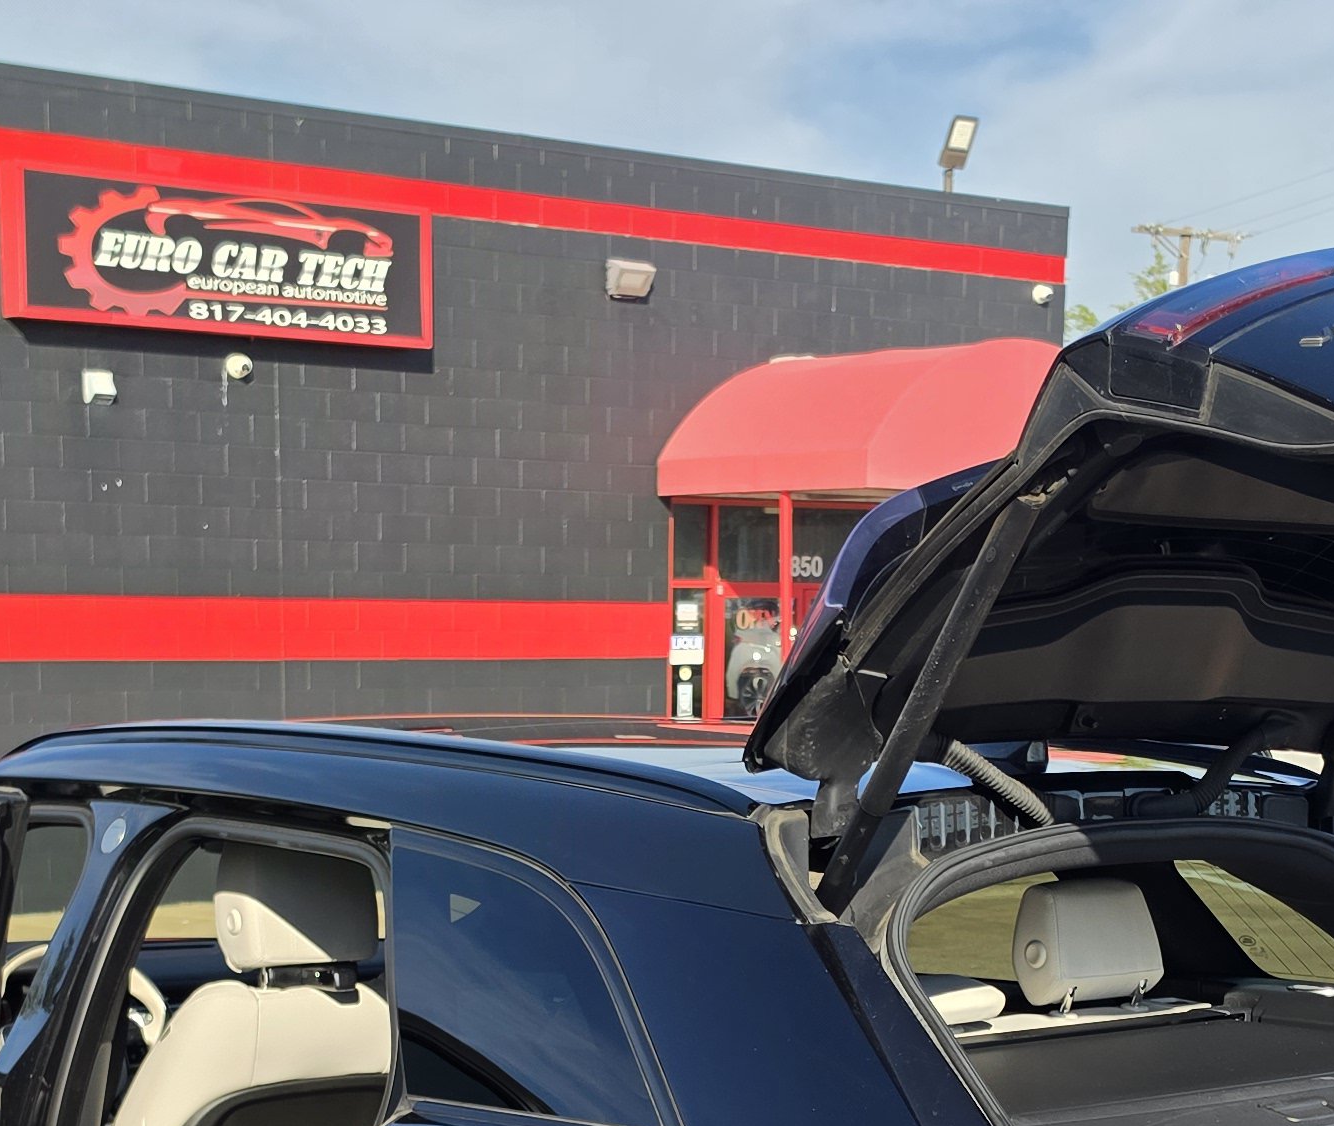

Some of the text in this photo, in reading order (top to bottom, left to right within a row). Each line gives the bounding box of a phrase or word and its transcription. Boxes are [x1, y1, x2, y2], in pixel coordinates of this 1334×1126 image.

[94, 230, 392, 292] EURO CAR TECH
[186, 275, 387, 306] european automotive
[188, 301, 388, 334] 817-404-4033
[778, 556, 823, 577] 850
